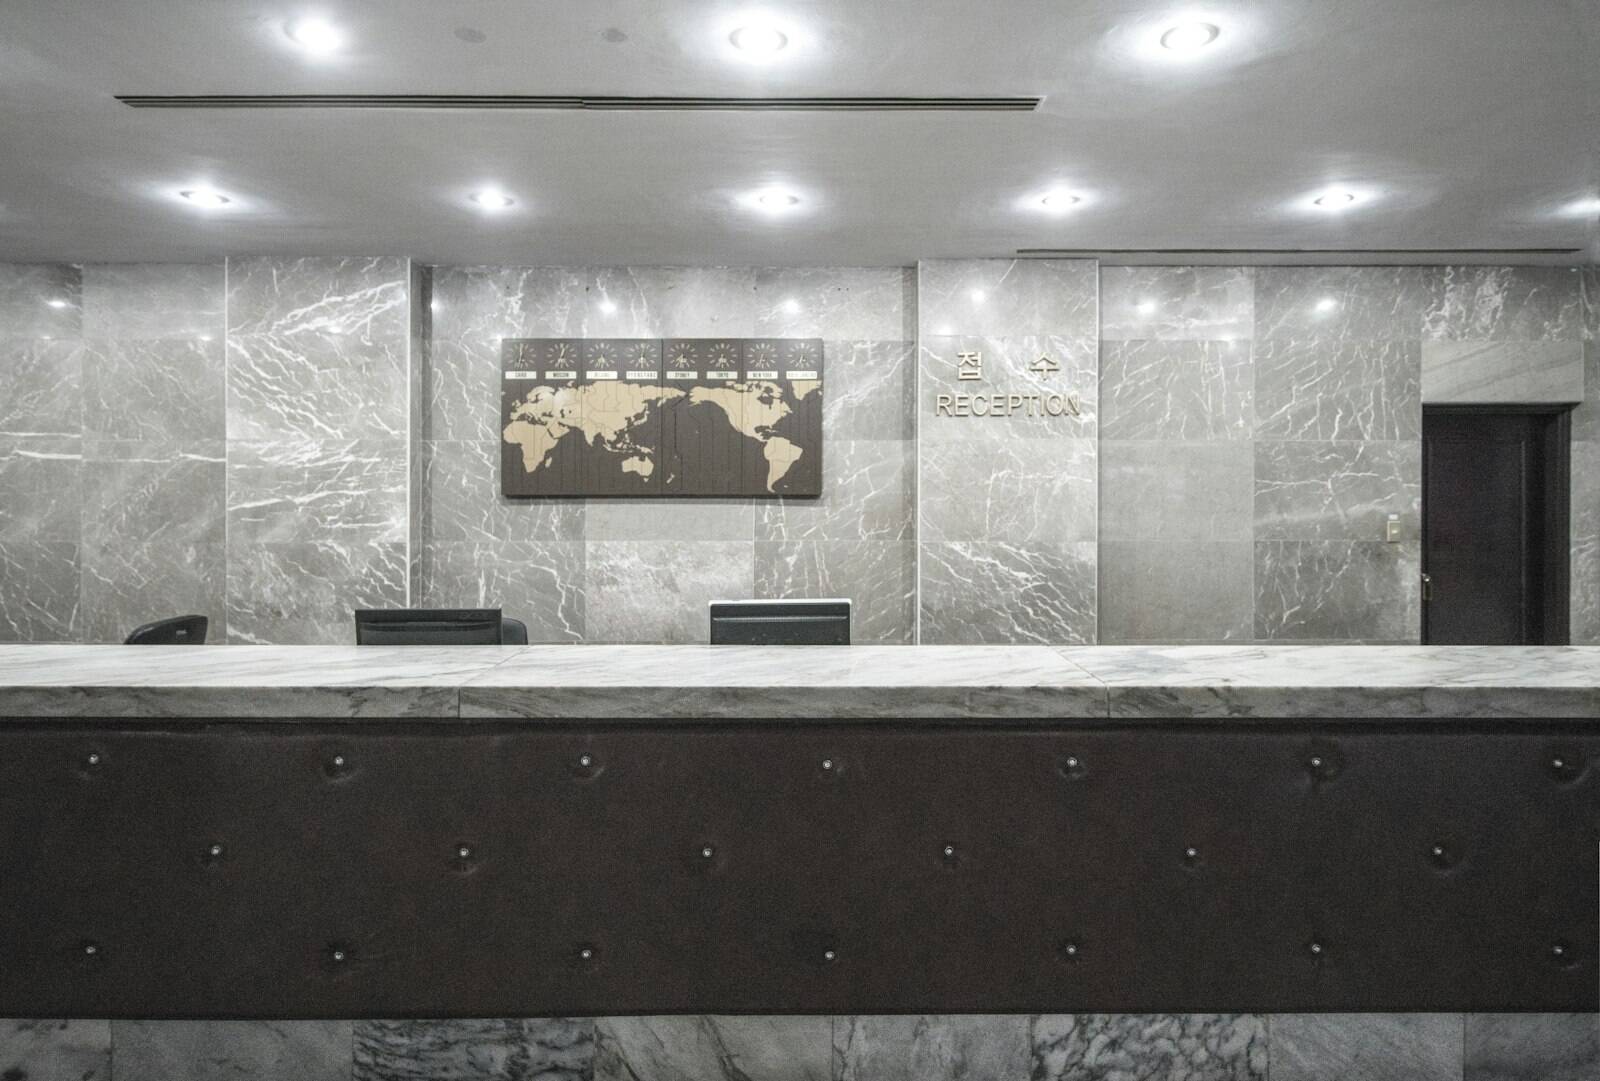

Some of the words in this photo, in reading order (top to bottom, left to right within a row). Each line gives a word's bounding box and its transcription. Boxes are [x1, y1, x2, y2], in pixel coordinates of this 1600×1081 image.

[956, 351, 983, 382] 접
[1029, 351, 1060, 382] 수
[935, 393, 1081, 417] RECEPTION
